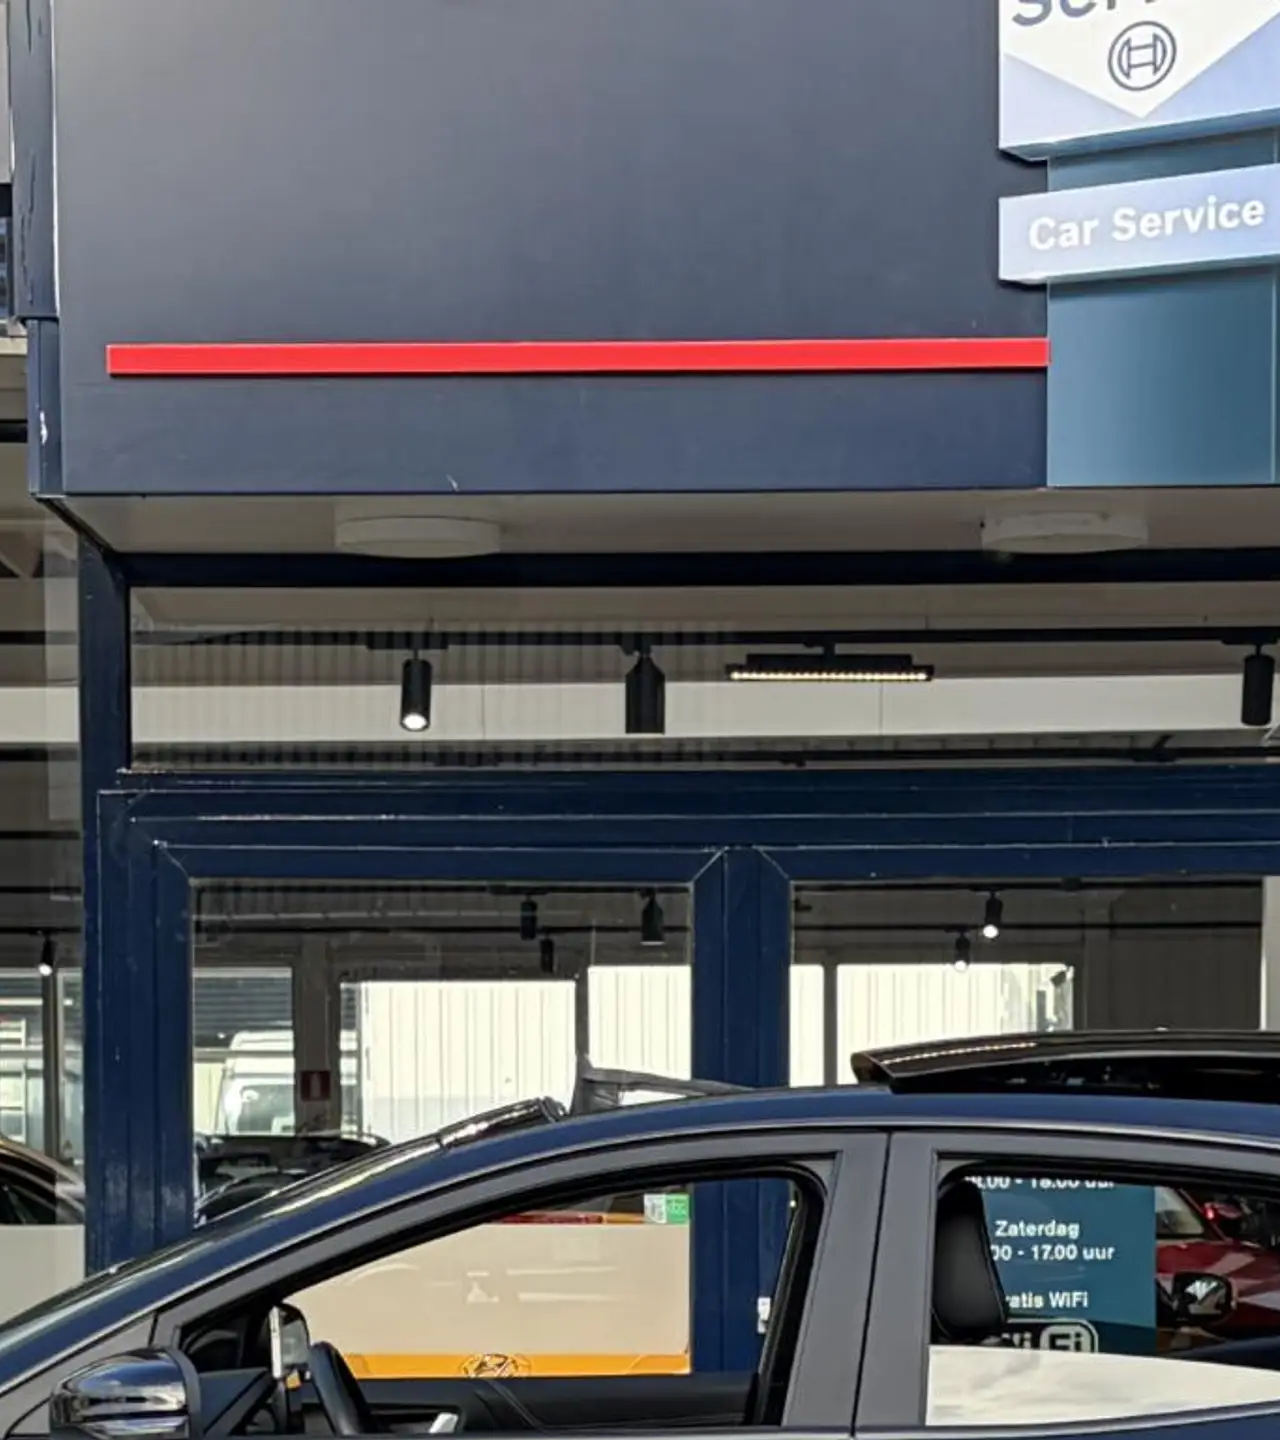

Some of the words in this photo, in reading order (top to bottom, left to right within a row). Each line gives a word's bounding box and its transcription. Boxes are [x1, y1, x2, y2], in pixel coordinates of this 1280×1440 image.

[1029, 216, 1099, 250] Car
[1111, 195, 1266, 242] Service
[994, 1219, 1080, 1239] Zaterdag
[1031, 1244, 1078, 1261] 17.00
[1082, 1247, 1115, 1260] uur
[1048, 1290, 1089, 1308] WiFi
